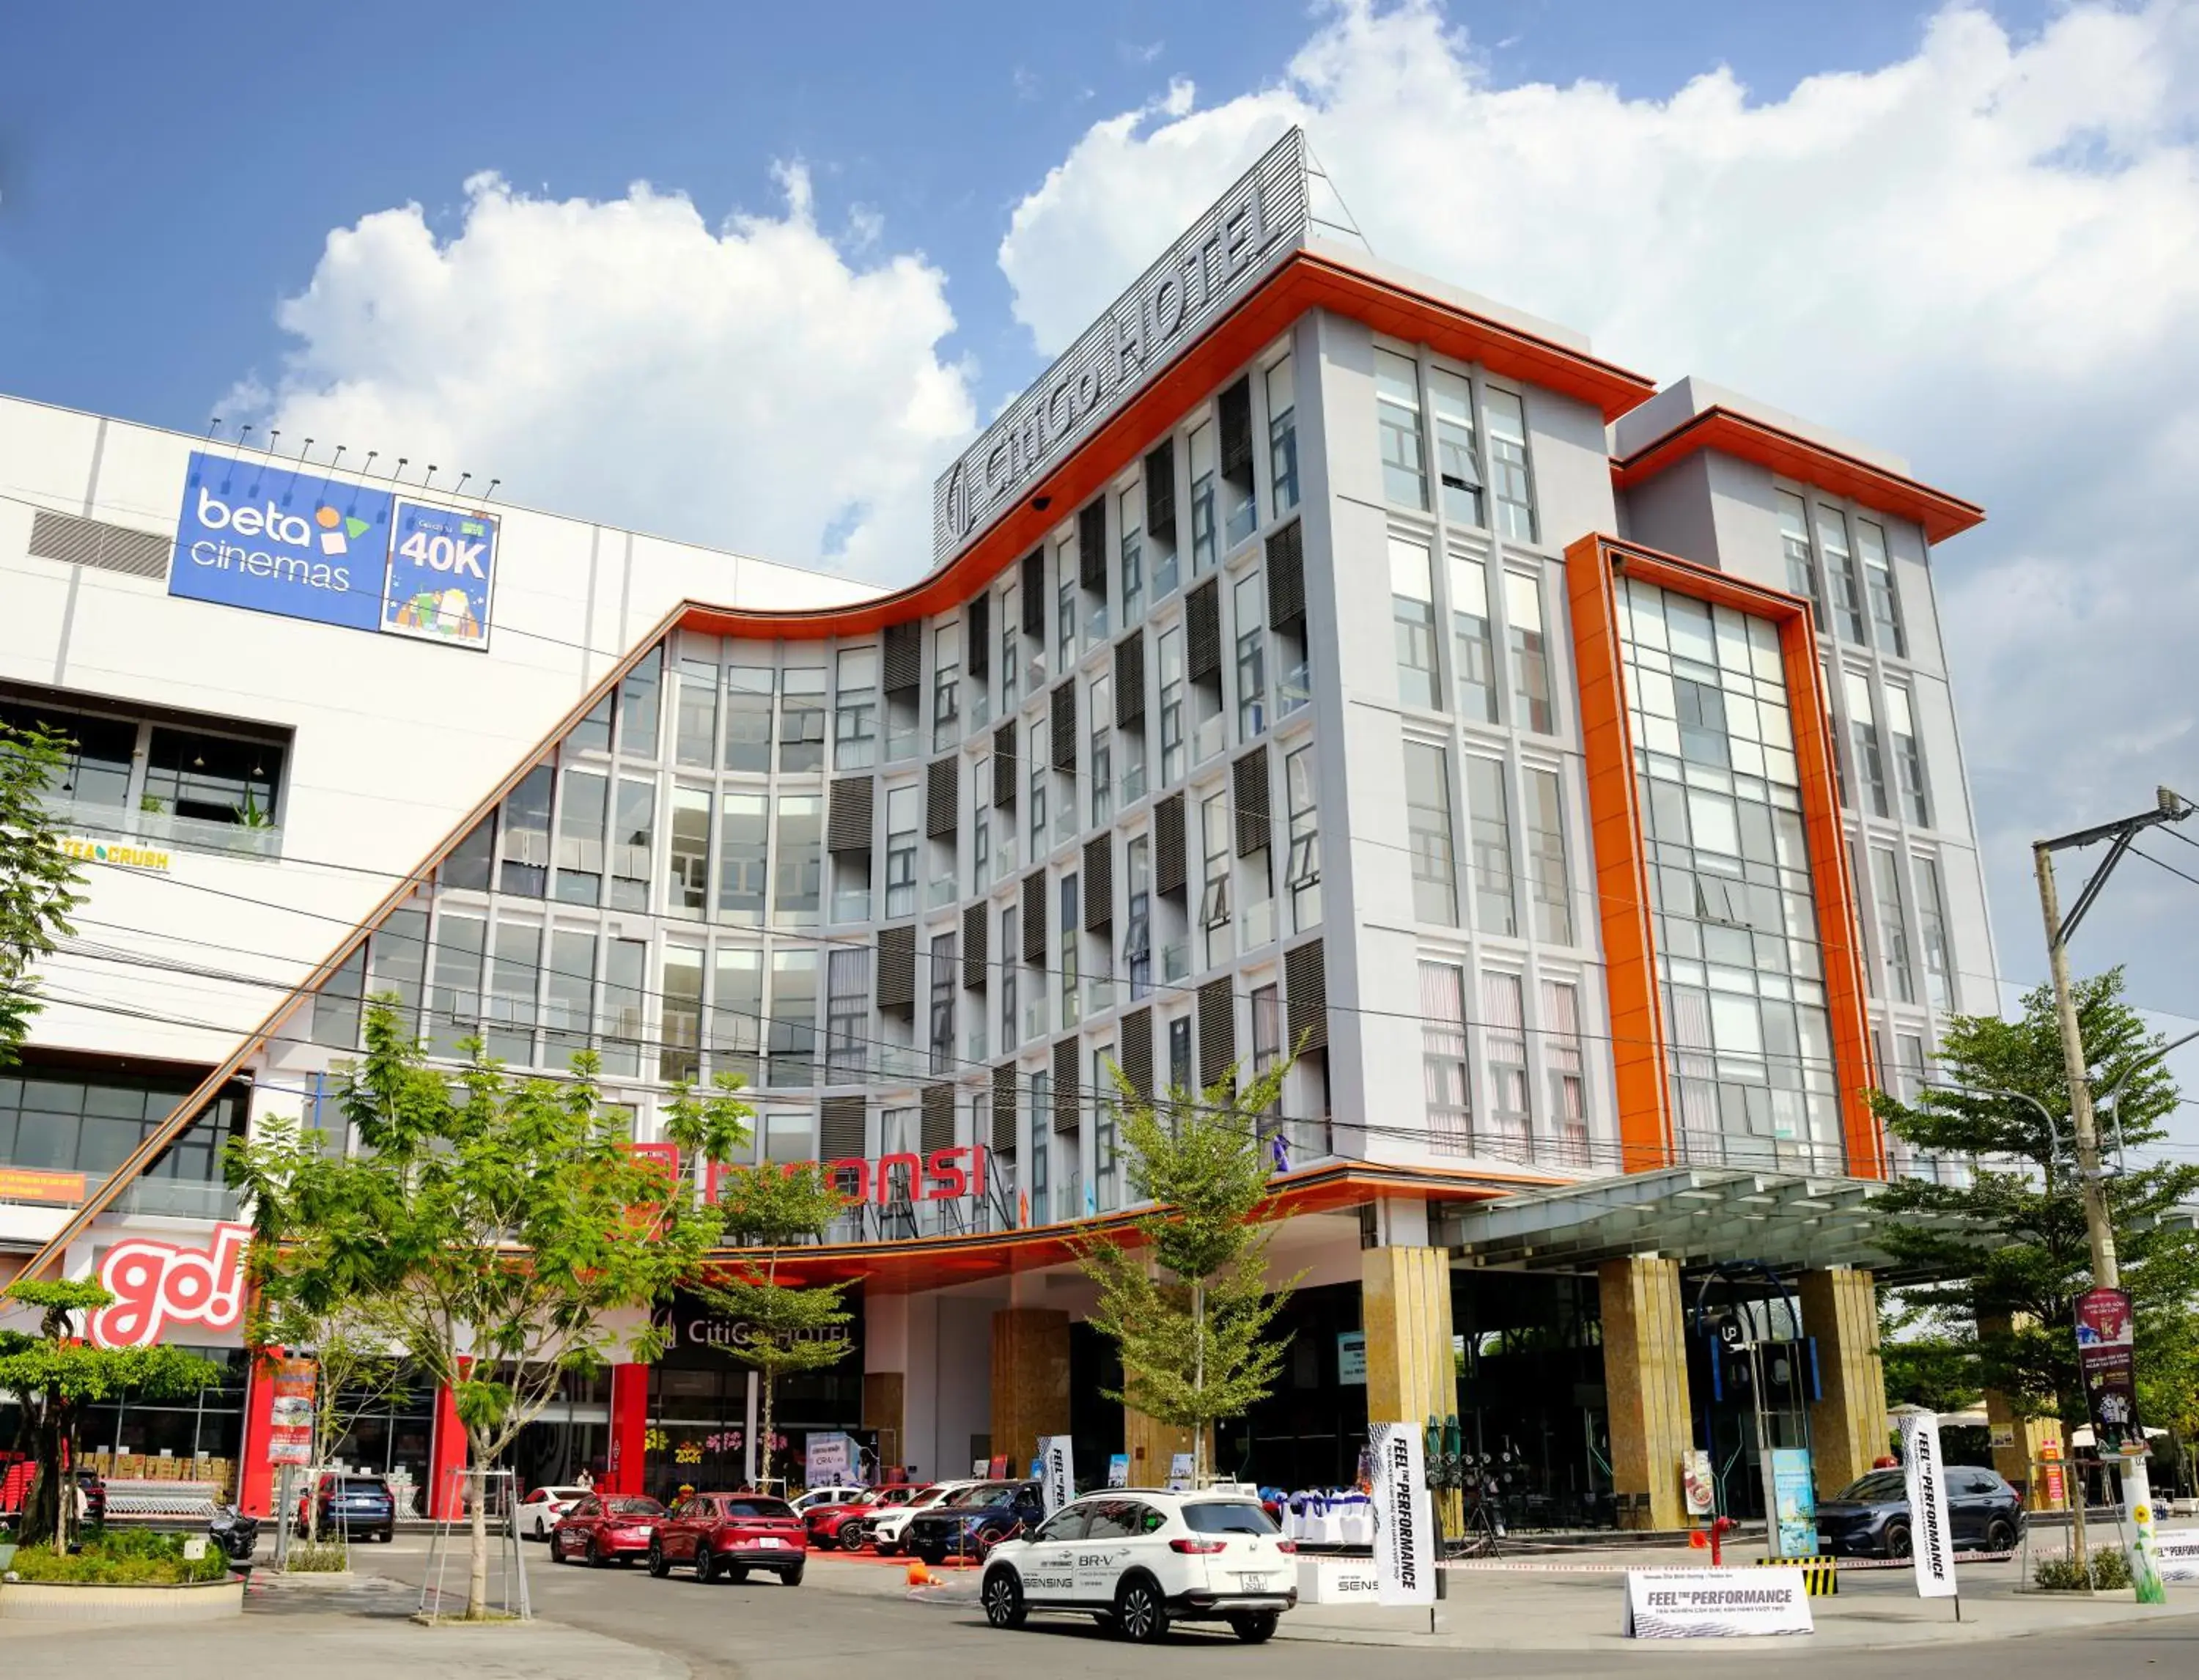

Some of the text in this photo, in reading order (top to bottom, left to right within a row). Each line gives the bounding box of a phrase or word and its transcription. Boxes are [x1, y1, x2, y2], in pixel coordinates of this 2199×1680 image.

[980, 188, 1282, 501] CitiGo HOTEL
[197, 486, 312, 548] beta
[191, 539, 350, 592] cinemas
[399, 531, 487, 581] 40K
[63, 839, 169, 870] TEA CRUSH
[93, 1228, 251, 1349] go!
[1053, 1448, 1064, 1474] FEEL
[1393, 1437, 1409, 1470] FEEL
[1918, 1431, 1930, 1462] FEEL
[1396, 1483, 1416, 1591] PERFORMANCE
[1922, 1475, 1945, 1581] PERFORMANCE
[1078, 1555, 1113, 1566] BR-V
[1023, 1578, 1072, 1588] SENSING
[1647, 1591, 1679, 1606] FEEL
[1691, 1588, 1792, 1605] PERFORMANCE
